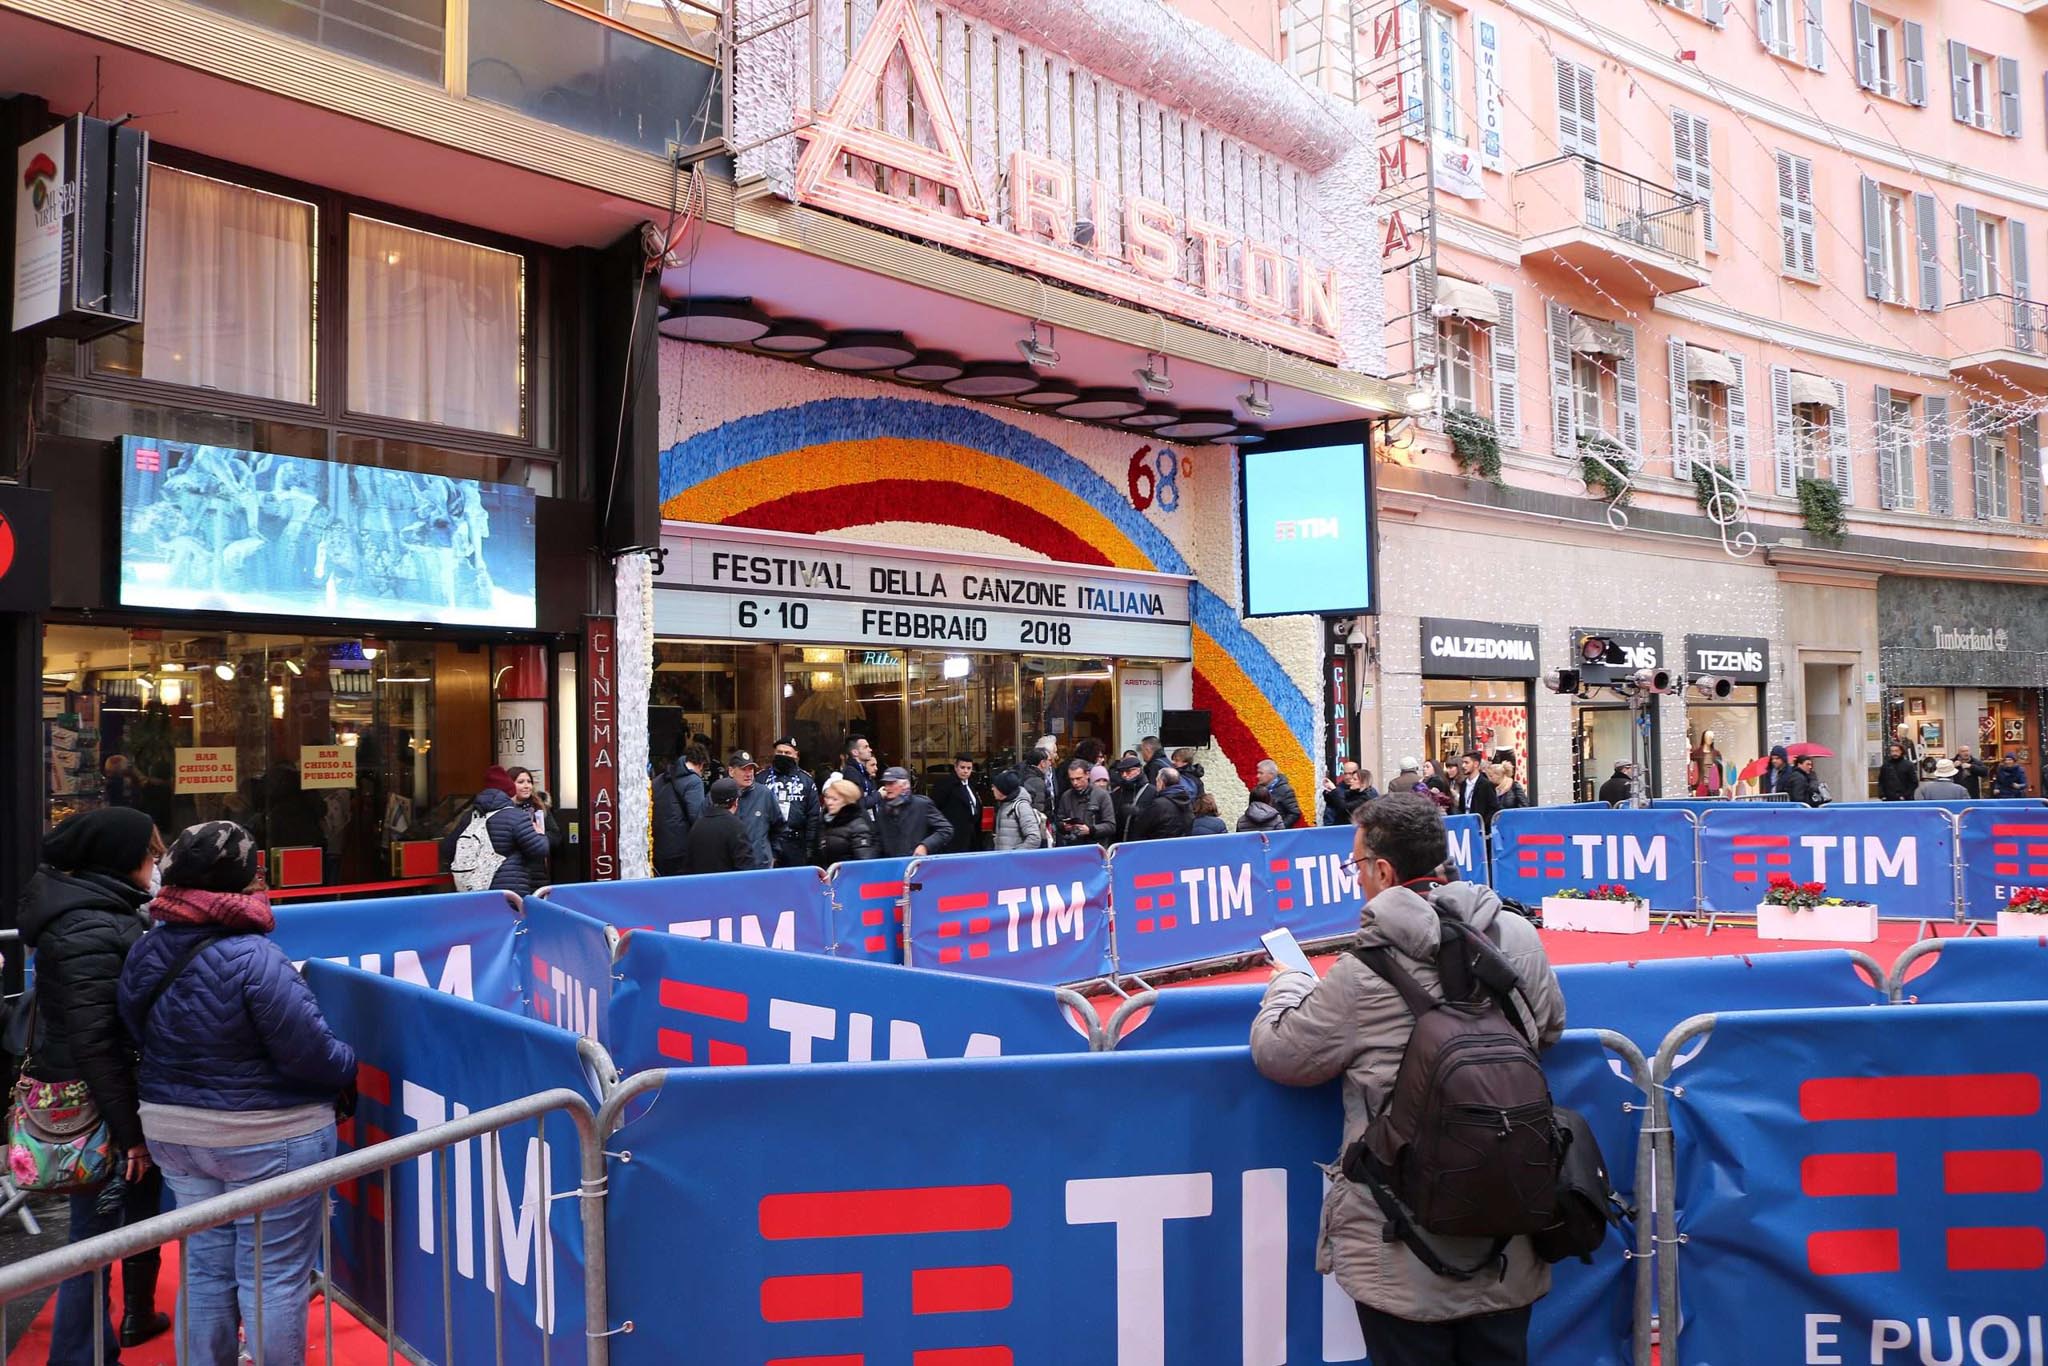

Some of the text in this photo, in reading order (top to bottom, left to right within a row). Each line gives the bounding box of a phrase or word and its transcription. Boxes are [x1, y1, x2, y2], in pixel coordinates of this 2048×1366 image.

[1484, 51, 1496, 128] MAICO
[795, 0, 1341, 337] ARISTON
[1299, 518, 1338, 538] TIM
[712, 552, 851, 590] FESTIVAL
[870, 567, 947, 598] DELLA
[963, 575, 1066, 608] CANZONE
[1078, 586, 1165, 616] ITALIANA
[862, 609, 987, 642] FEBBRAIO
[1020, 619, 1071, 646] 2018
[1430, 636, 1535, 662] CALZEDONIA
[1933, 625, 1994, 649] Timberland
[593, 632, 612, 768] CINEMA
[1334, 667, 1346, 777] CINEMA
[319, 750, 339, 758] BAR
[1136, 726, 1158, 734] 2018
[178, 775, 234, 784] PUBBLICO
[179, 764, 234, 773] CHIUSO AL
[195, 753, 217, 761] BAR
[303, 772, 354, 780] PUBBLICO
[304, 761, 340, 769] CHIUSO
[594, 788, 613, 880] ARIS
[1573, 834, 1668, 881] TIM
[1800, 835, 1917, 885] TIM
[997, 881, 1086, 953] TIM
[1180, 863, 1253, 925] TIM
[402, 1079, 556, 1335] TIM
[1065, 1168, 1367, 1366] TI
[1805, 1313, 2044, 1366] E PUOI
